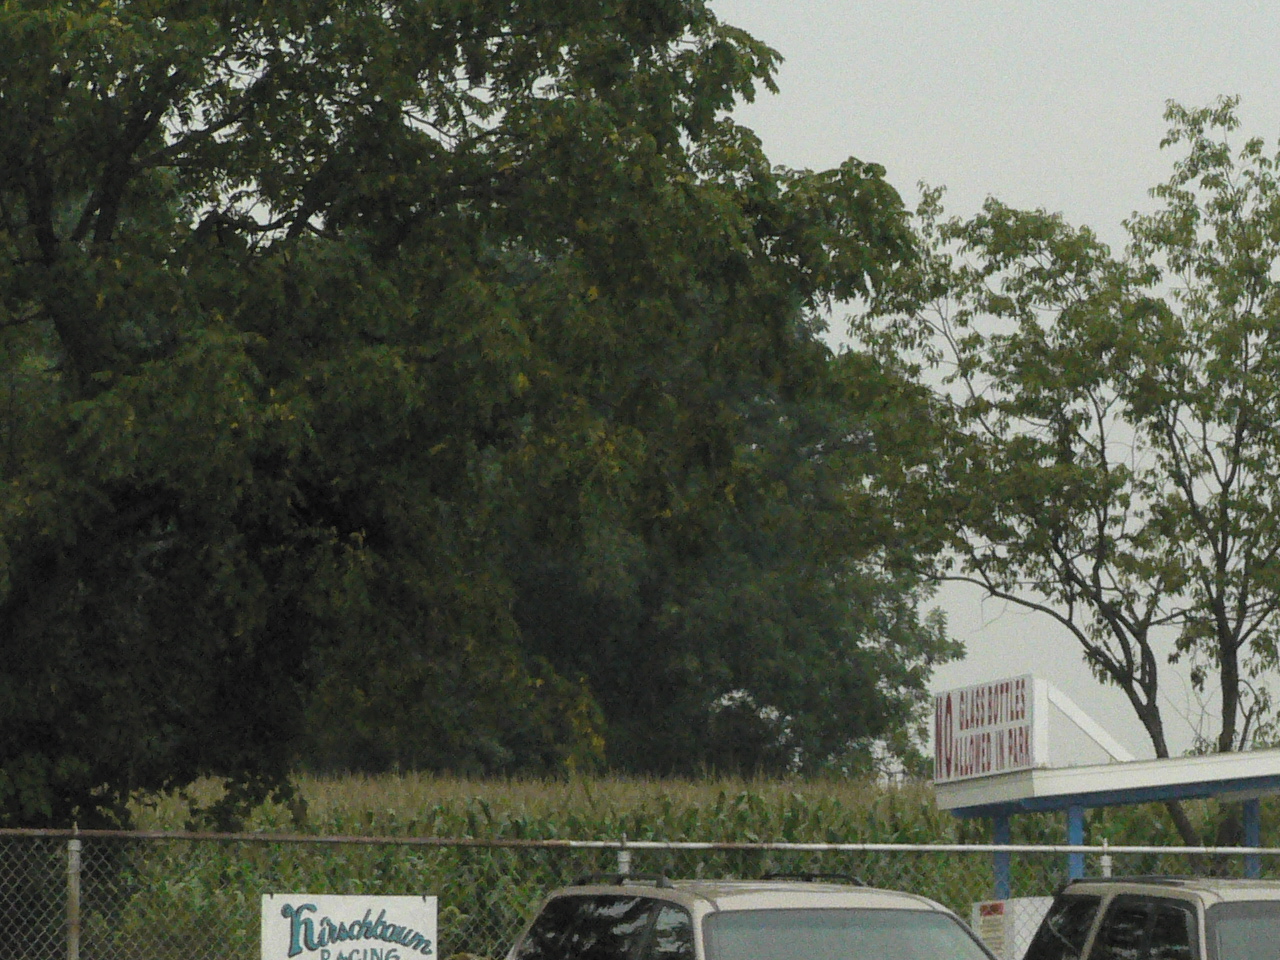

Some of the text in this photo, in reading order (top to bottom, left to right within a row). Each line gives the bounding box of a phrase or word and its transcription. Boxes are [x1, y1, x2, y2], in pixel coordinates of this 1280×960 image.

[959, 678, 1026, 730] GLASS BOTTLES
[935, 691, 953, 778] NO
[954, 726, 1031, 778] ALLOWED IN PARK
